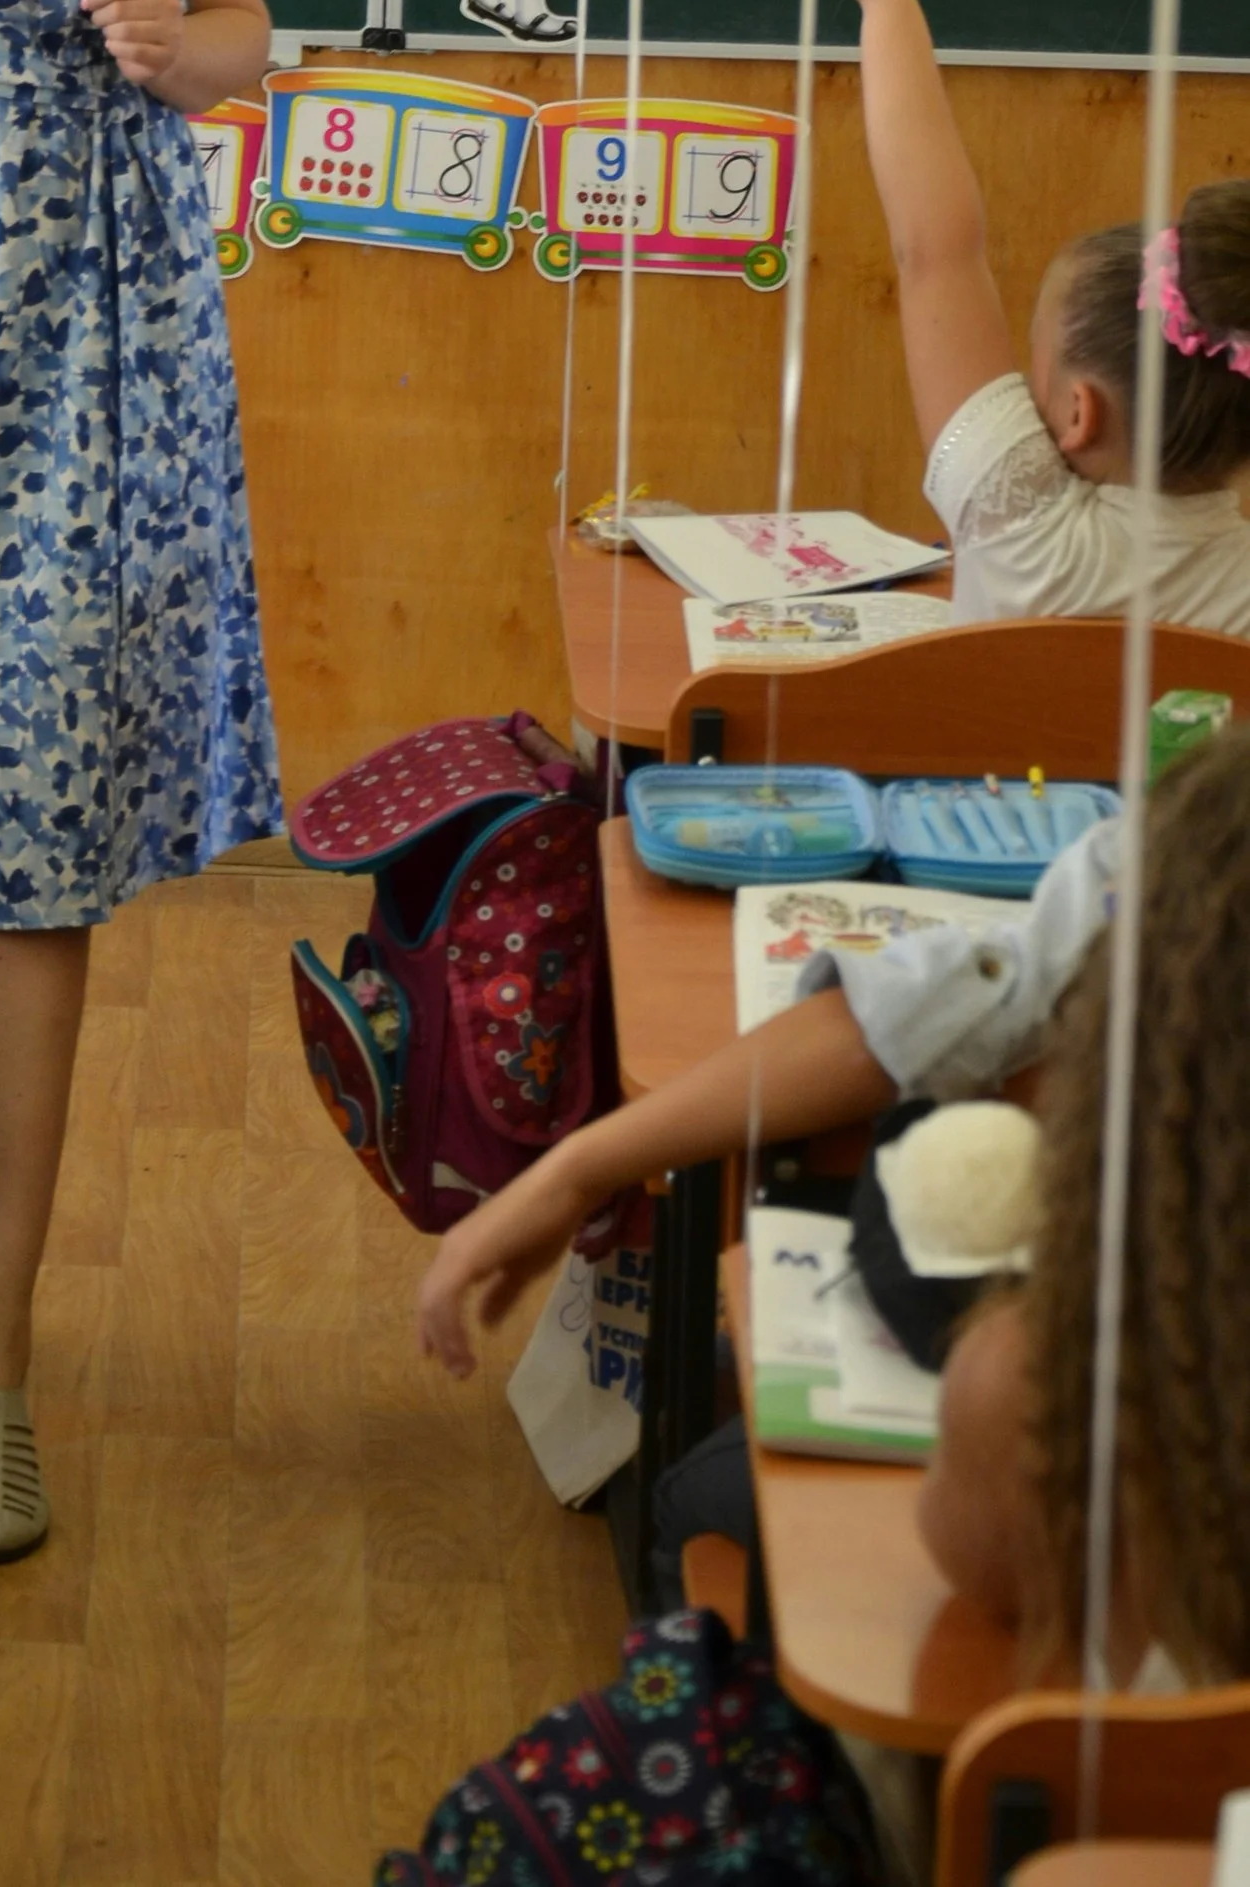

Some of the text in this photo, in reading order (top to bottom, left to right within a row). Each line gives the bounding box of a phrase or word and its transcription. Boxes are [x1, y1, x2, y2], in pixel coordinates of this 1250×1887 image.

[323, 107, 483, 198] 8 8
[595, 136, 757, 220] 9 9
